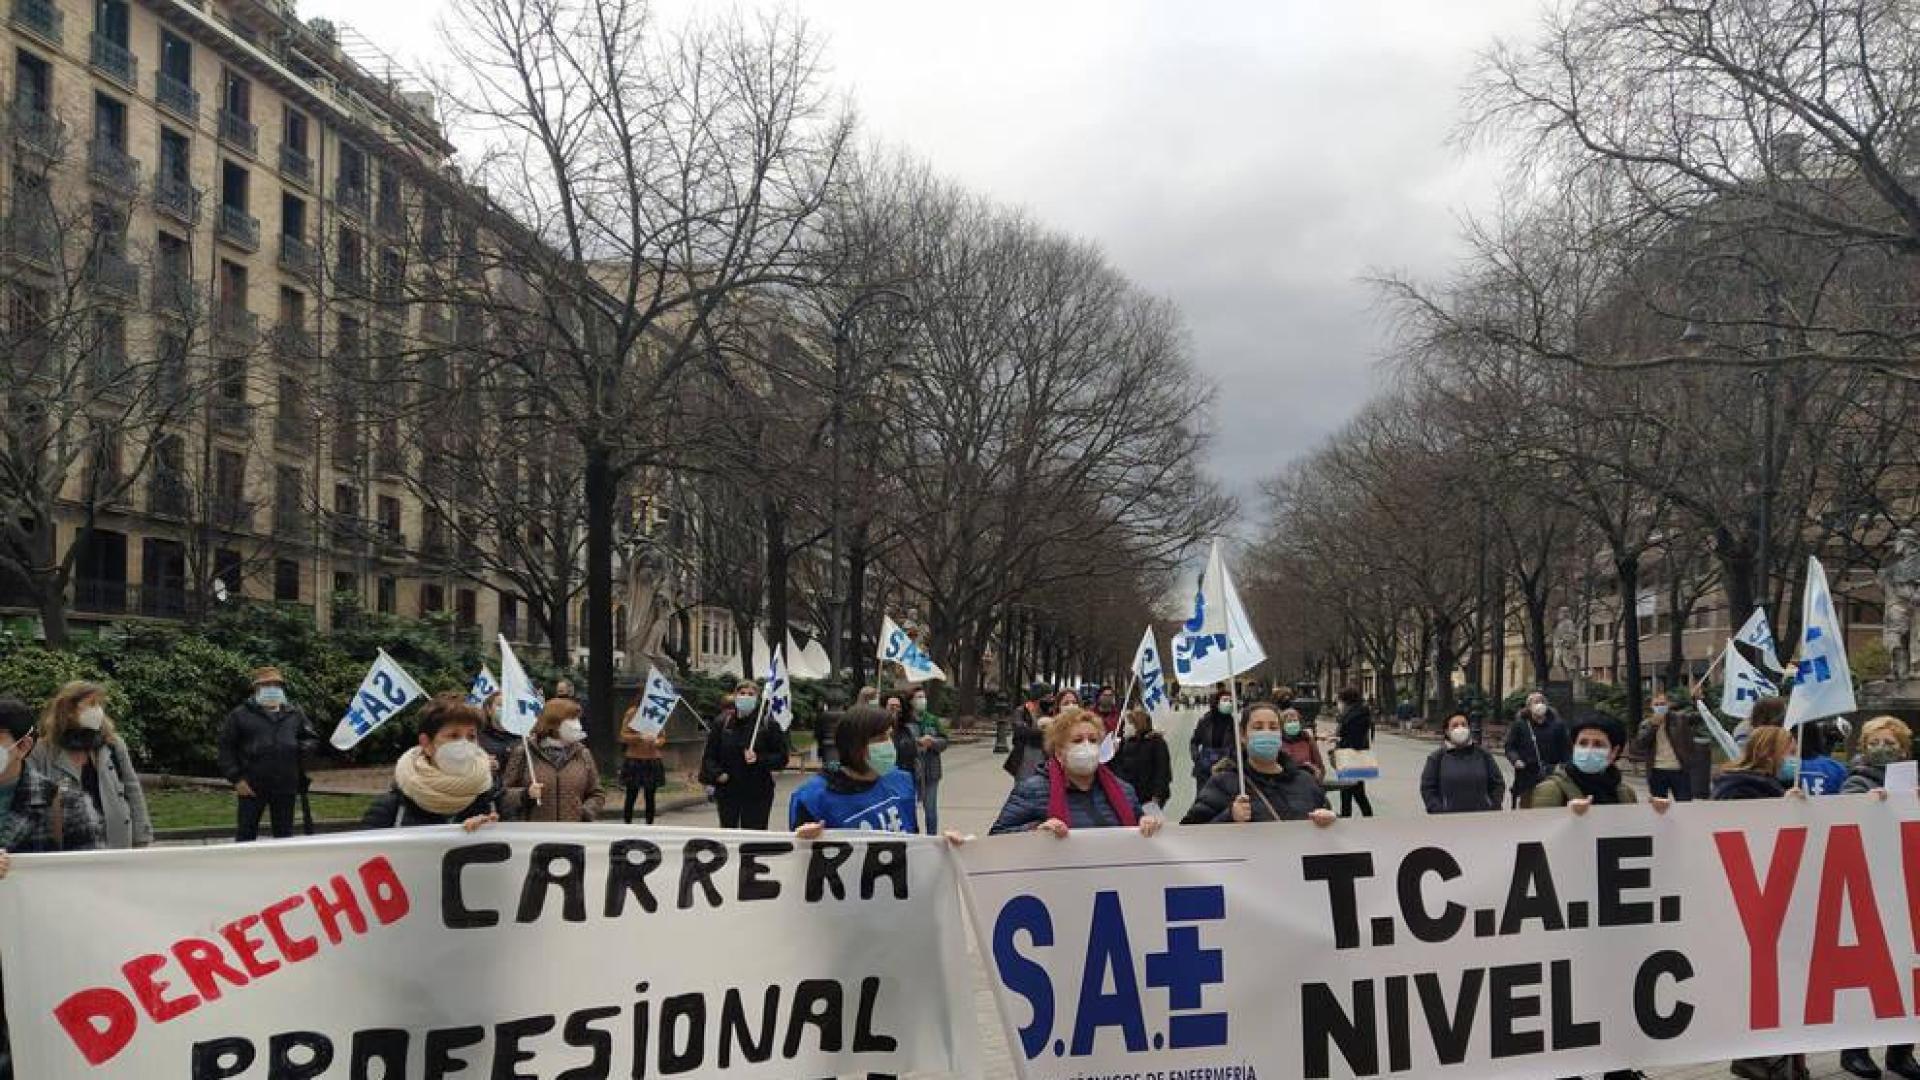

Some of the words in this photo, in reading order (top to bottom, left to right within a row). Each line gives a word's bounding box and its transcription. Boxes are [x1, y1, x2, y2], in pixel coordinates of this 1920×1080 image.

[53, 855, 410, 1067] DERECHO
[441, 838, 908, 929] CARRERA
[1301, 835, 1681, 950] T.C.A.E.
[1301, 959, 1600, 1079] NIVEL
[1634, 949, 1695, 1040] C
